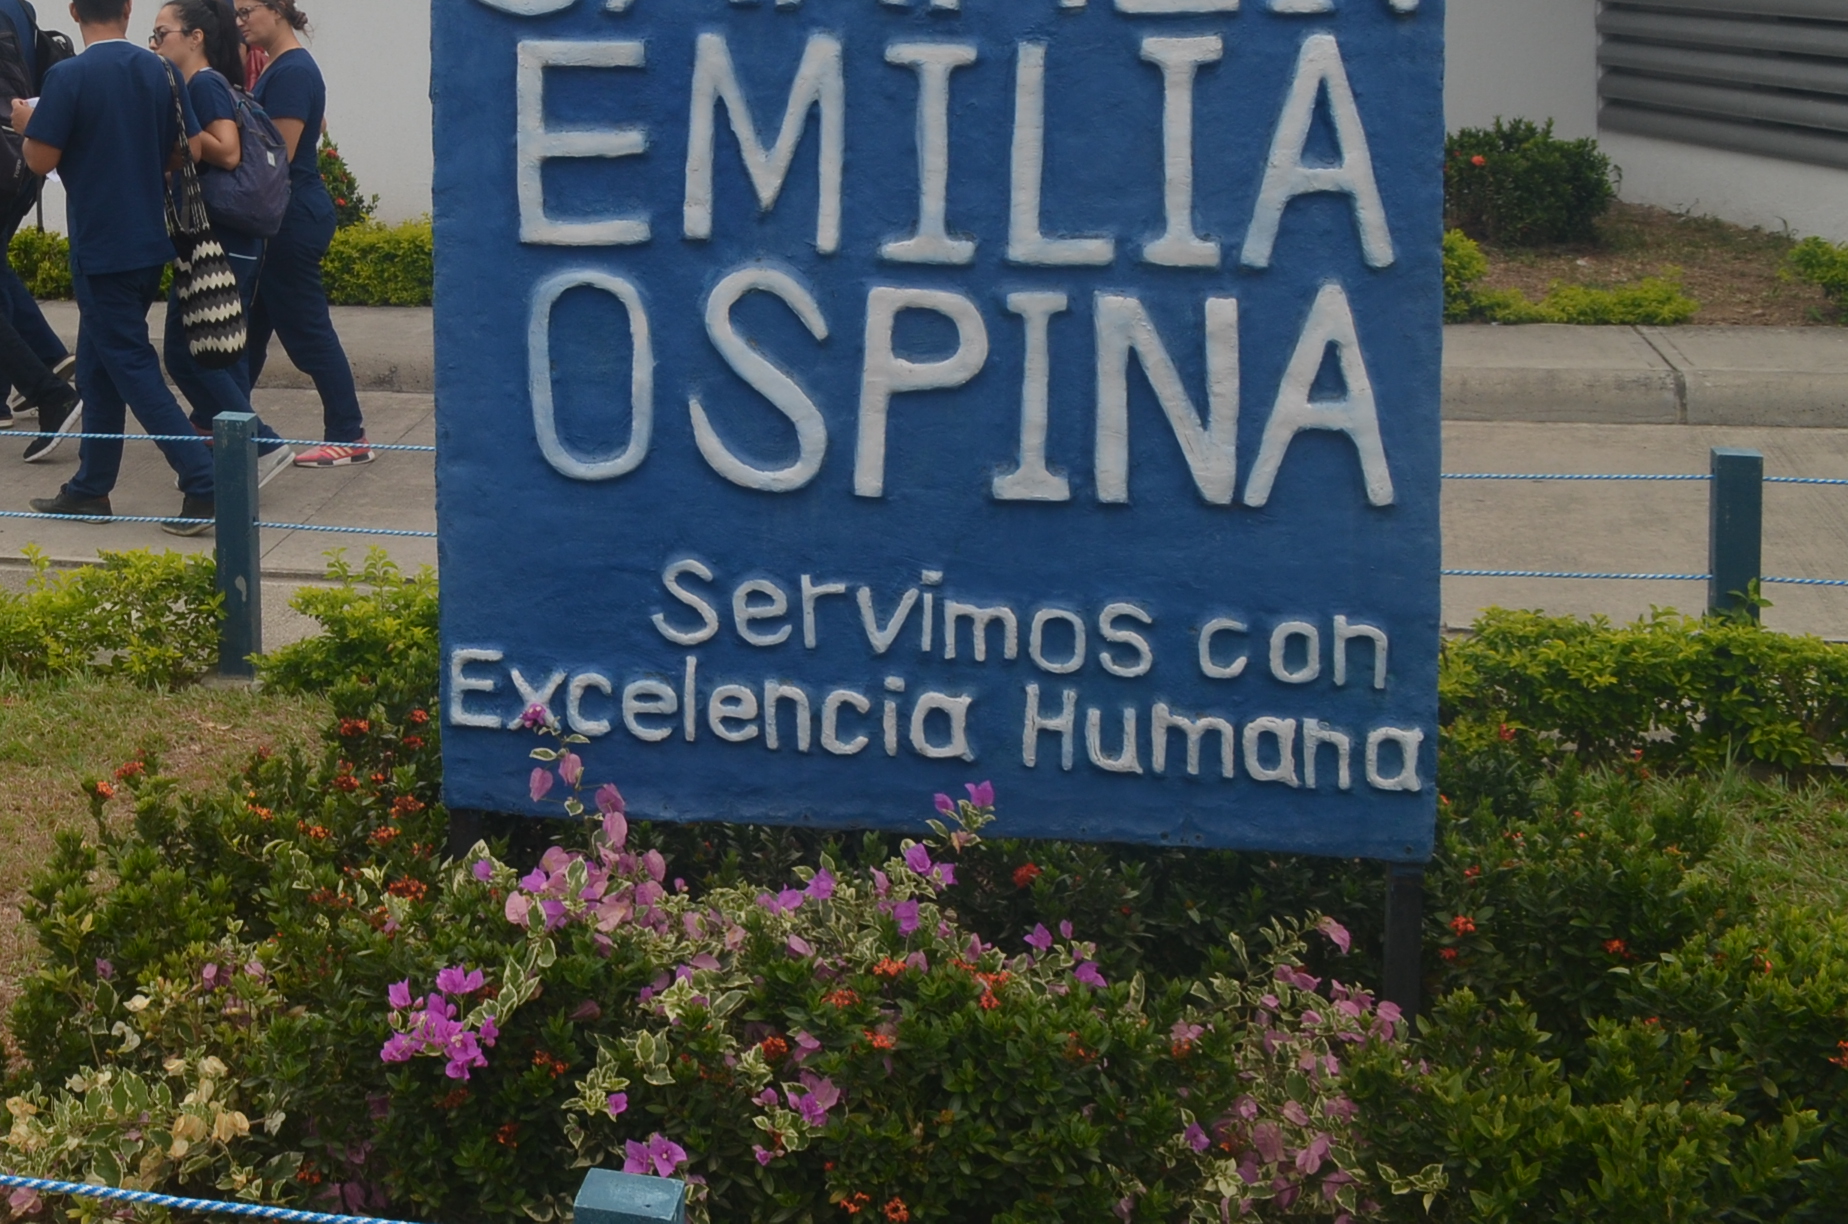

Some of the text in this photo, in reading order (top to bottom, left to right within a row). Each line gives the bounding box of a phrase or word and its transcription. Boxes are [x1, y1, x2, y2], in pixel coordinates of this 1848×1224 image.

[516, 33, 1395, 268] EMILIA
[528, 269, 1395, 507] OSPINA
[651, 558, 1388, 690] Servimos con
[449, 648, 1424, 792] Excelencia Humana
